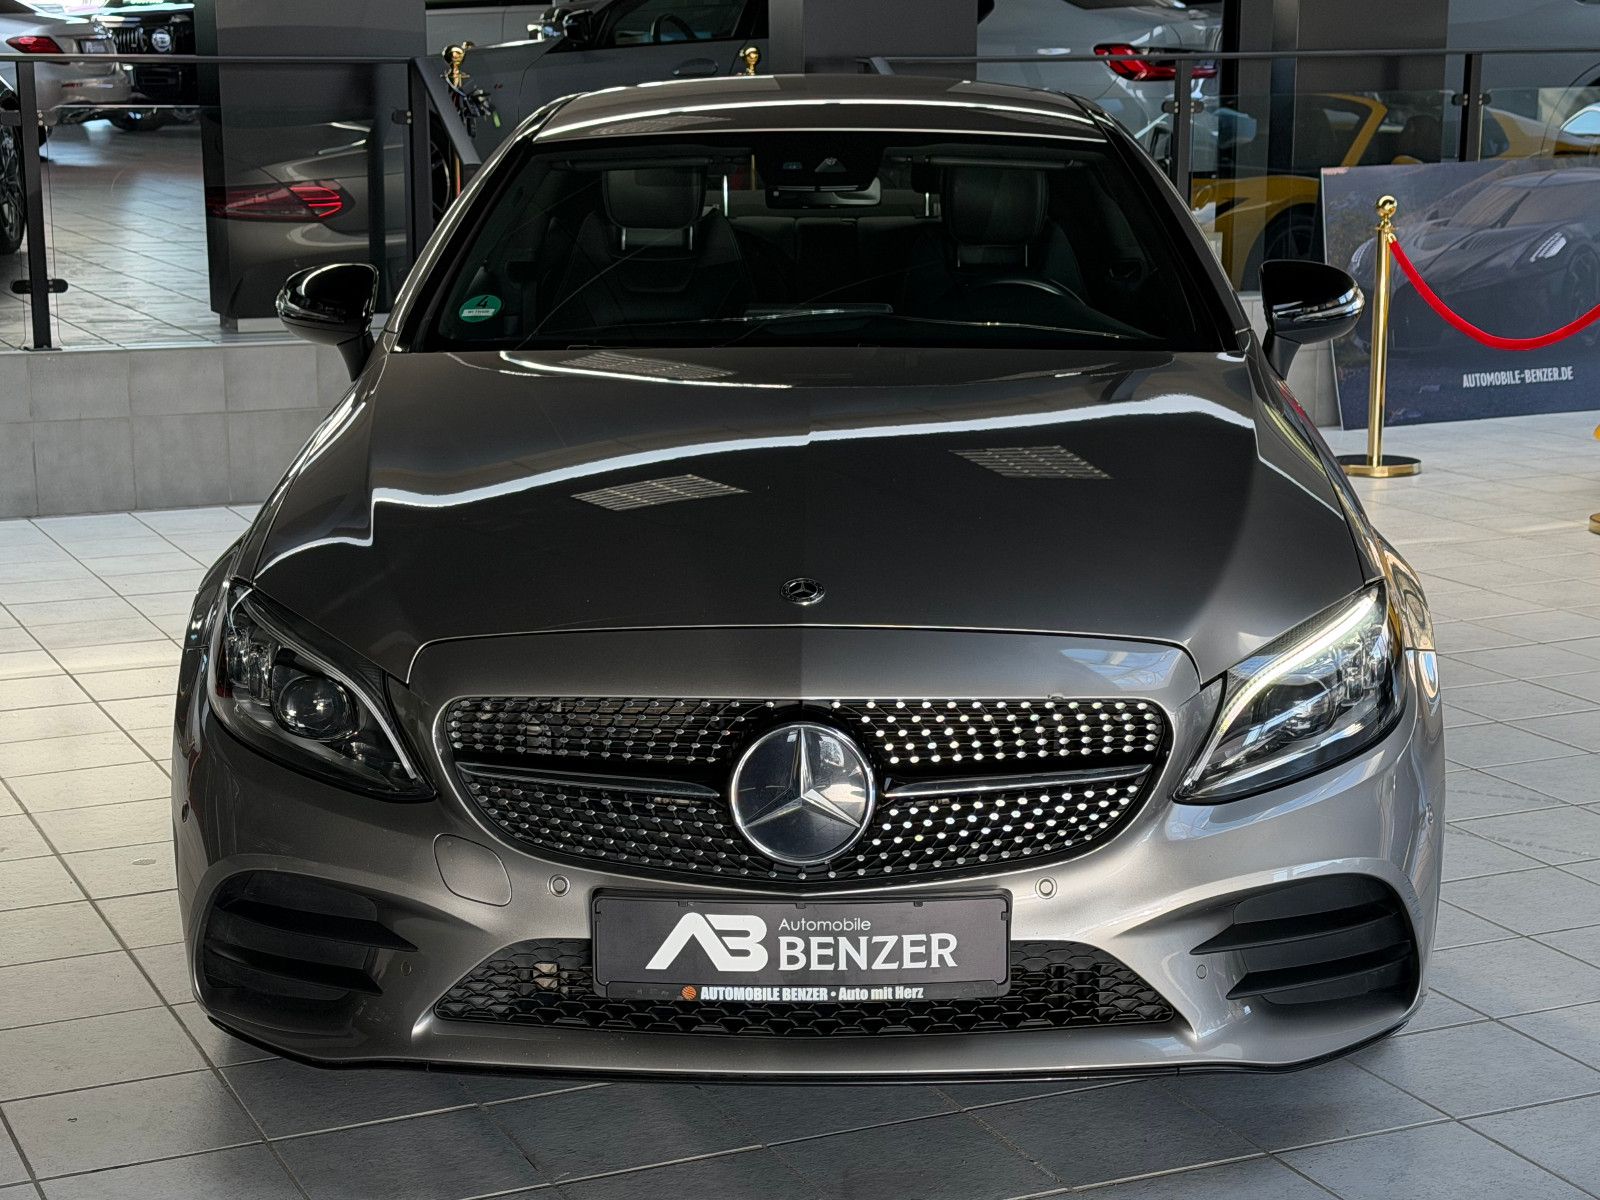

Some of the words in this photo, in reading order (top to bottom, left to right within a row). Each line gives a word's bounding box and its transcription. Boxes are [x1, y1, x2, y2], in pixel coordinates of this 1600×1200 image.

[477, 296, 489, 308] 4
[1463, 366, 1574, 388] AUTOMOBILE-BENZER.DE
[778, 918, 871, 931] Automobile
[778, 933, 958, 971] BENZER
[701, 987, 780, 1001] AUTOMOBILE
[782, 988, 828, 1001] BENZER
[838, 987, 869, 1001] Auto
[871, 987, 893, 1000] mit
[895, 986, 924, 1000] Herz
